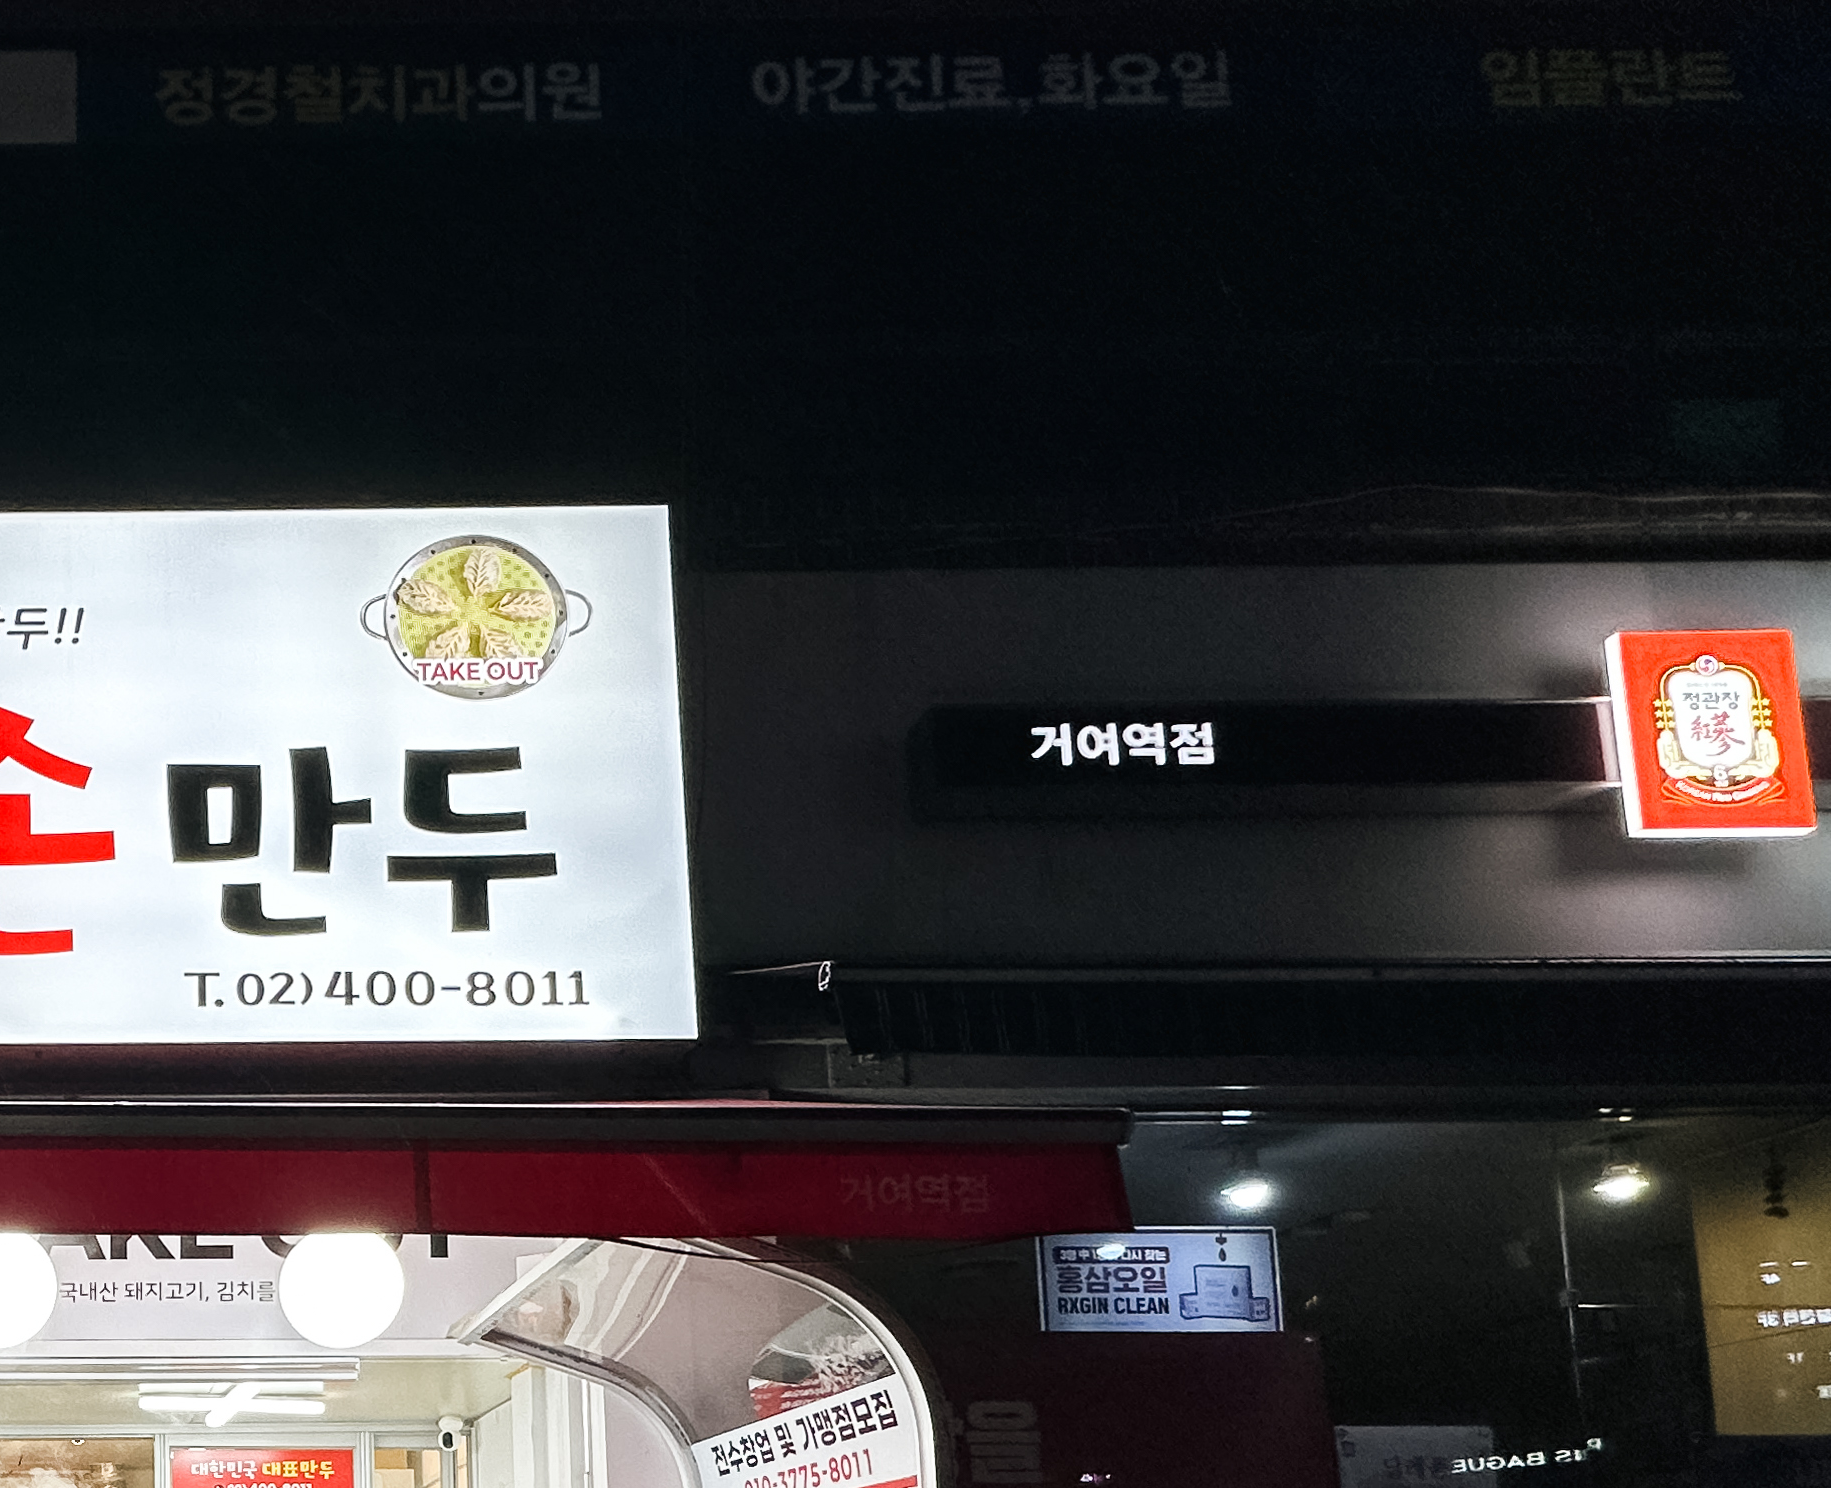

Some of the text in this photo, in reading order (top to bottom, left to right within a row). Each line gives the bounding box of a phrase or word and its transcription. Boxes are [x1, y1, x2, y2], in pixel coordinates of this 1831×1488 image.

[156, 63, 603, 127] 정경철치과의원
[419, 657, 543, 683] TAKE OUT
[1683, 691, 1740, 710] 정관장
[1031, 722, 1216, 765] 거여역점
[840, 1173, 989, 1214] 거여역점
[60, 1281, 276, 1304] 국내산 돼지고기, 김치를
[1057, 1265, 1168, 1293] 홍삼오일
[1058, 1297, 1170, 1314] RXGIN CLEAN
[711, 1389, 899, 1478] 전수창업 및 가맹점모집
[191, 1459, 336, 1479] 대한민국 대표만두
